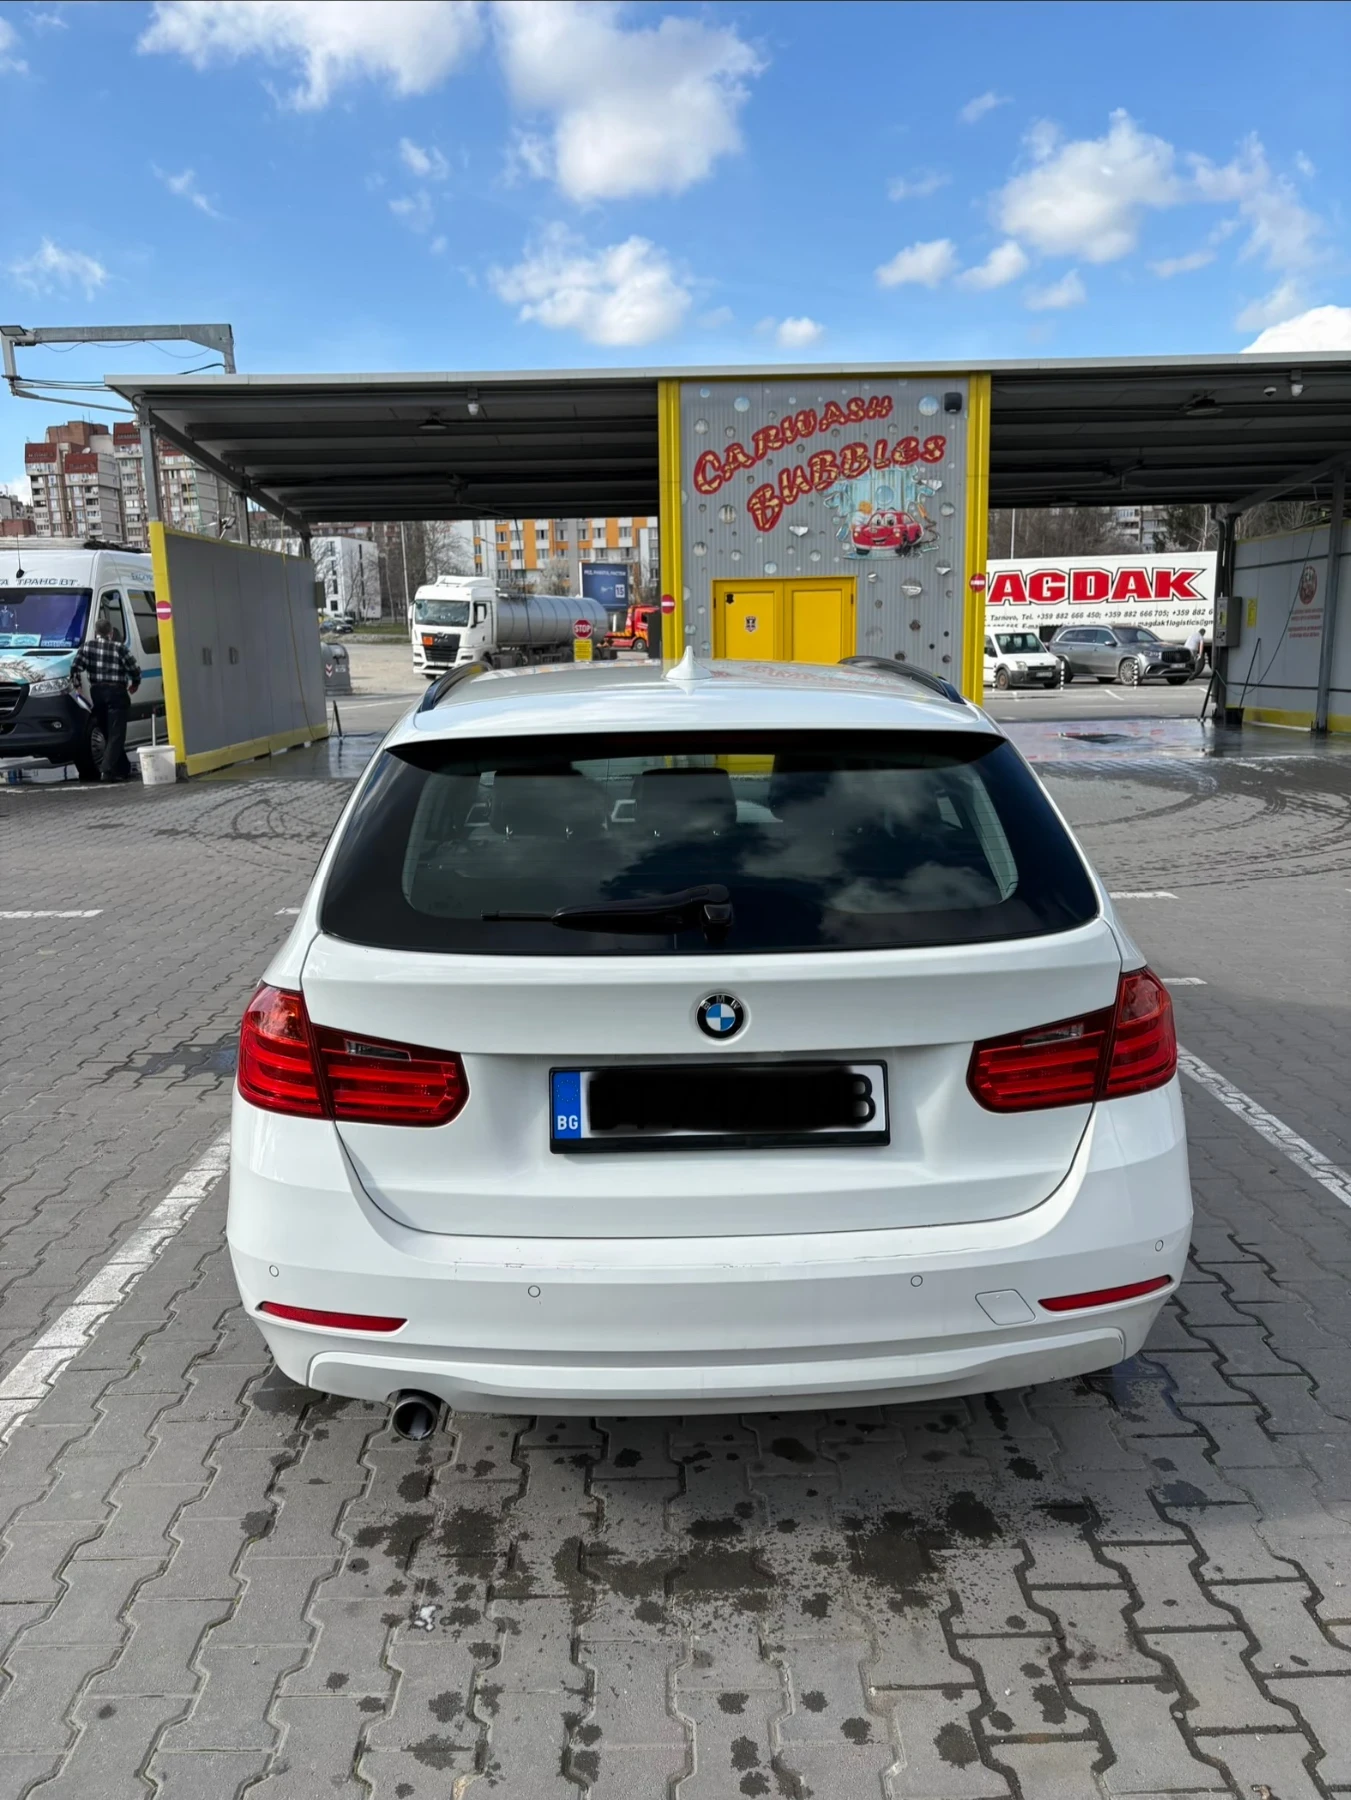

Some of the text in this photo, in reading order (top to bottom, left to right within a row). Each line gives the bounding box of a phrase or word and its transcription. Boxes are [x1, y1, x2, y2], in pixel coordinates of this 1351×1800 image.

[693, 395, 893, 494] CARWASH
[985, 567, 1208, 606] AGDAK
[574, 624, 591, 633] STOP
[557, 1115, 578, 1130] BG
